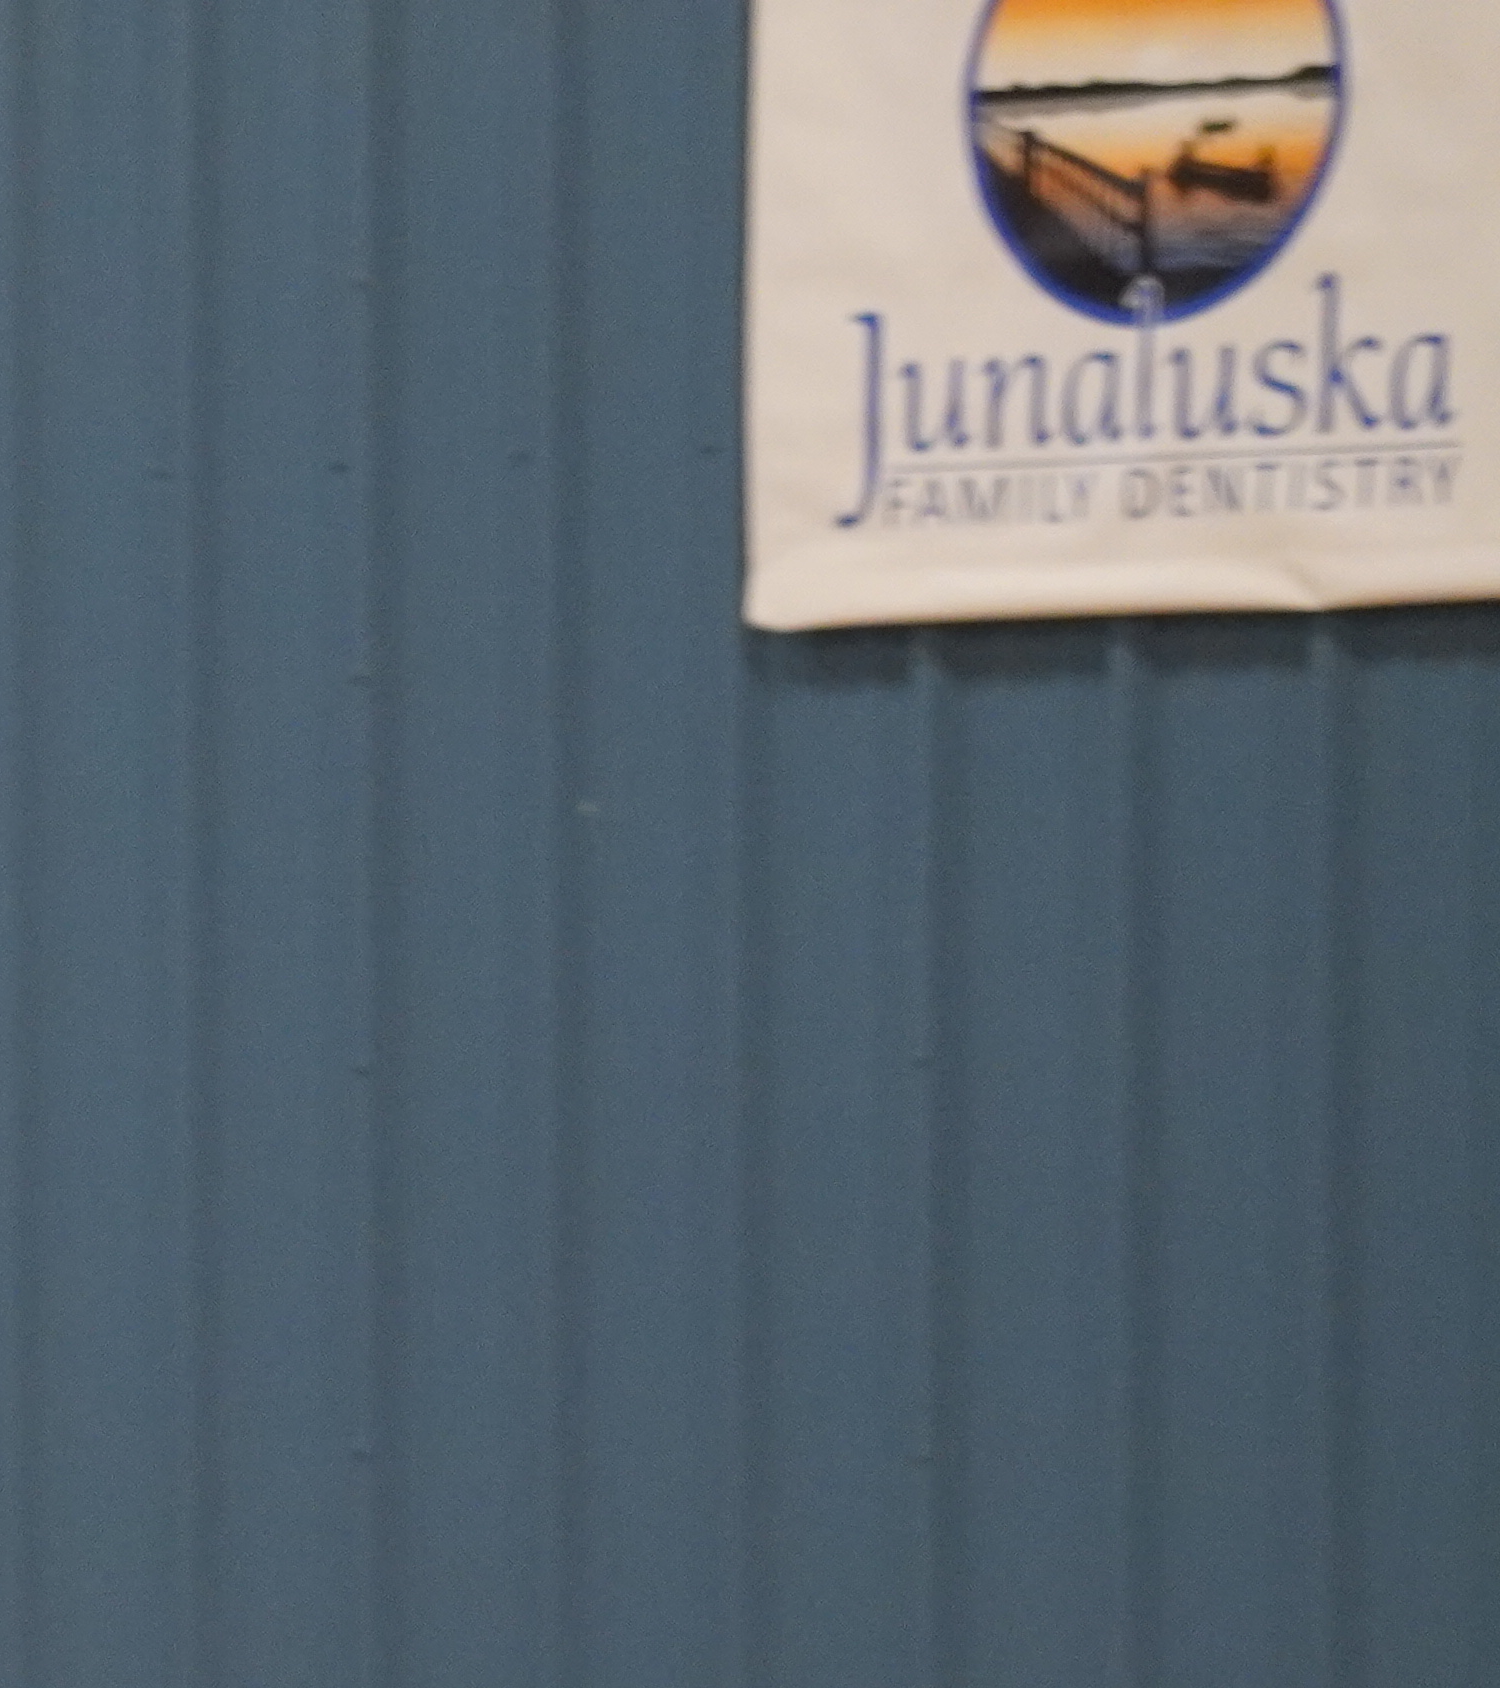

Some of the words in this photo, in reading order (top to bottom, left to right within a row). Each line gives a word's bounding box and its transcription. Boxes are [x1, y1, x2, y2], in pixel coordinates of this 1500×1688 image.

[835, 272, 1456, 528] Junaluska
[883, 474, 1093, 526] FAMILY
[1118, 456, 1463, 520] DENTISTRY
